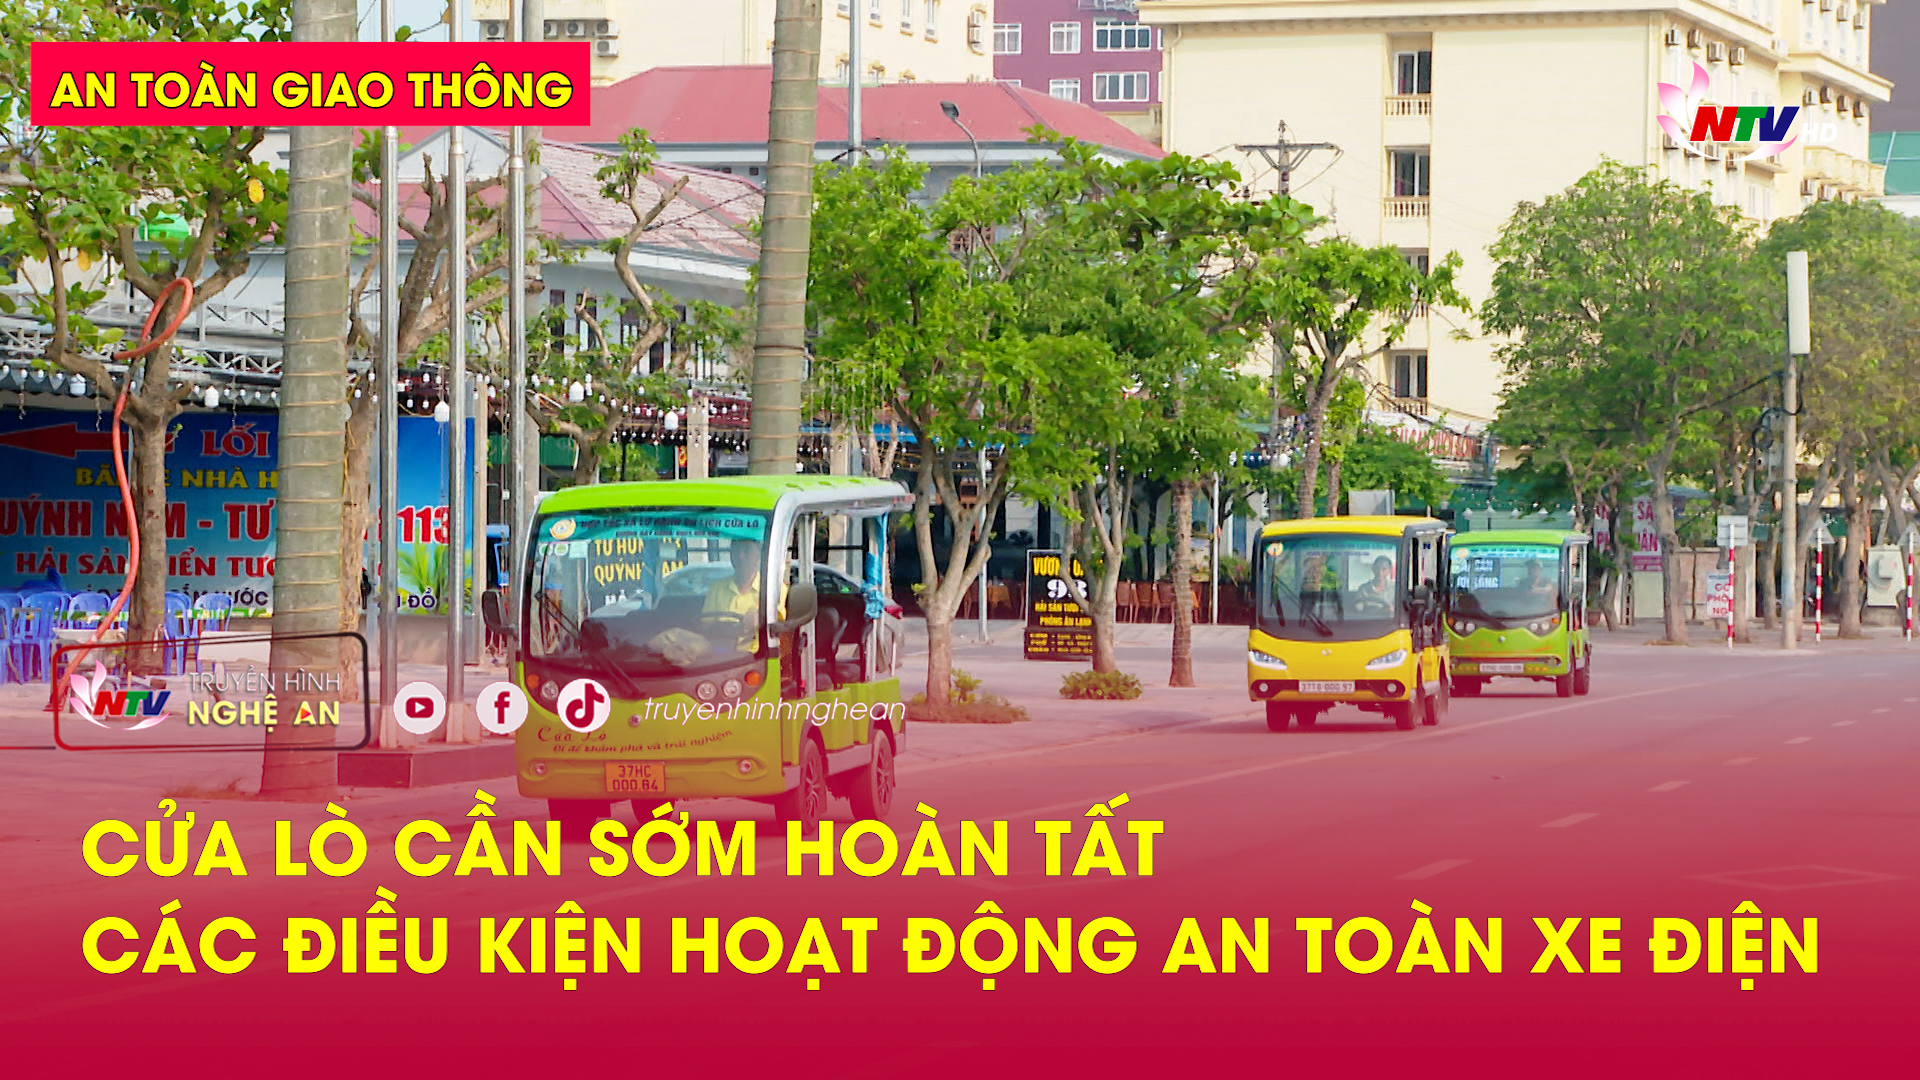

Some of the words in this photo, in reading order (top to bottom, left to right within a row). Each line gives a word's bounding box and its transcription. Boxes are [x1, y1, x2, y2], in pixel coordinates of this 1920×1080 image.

[181, 466, 249, 489] NHÀ
[0, 493, 92, 537] UÝNH
[104, 501, 187, 539] NM
[15, 547, 68, 575] HẢI
[167, 547, 216, 577] IỂN
